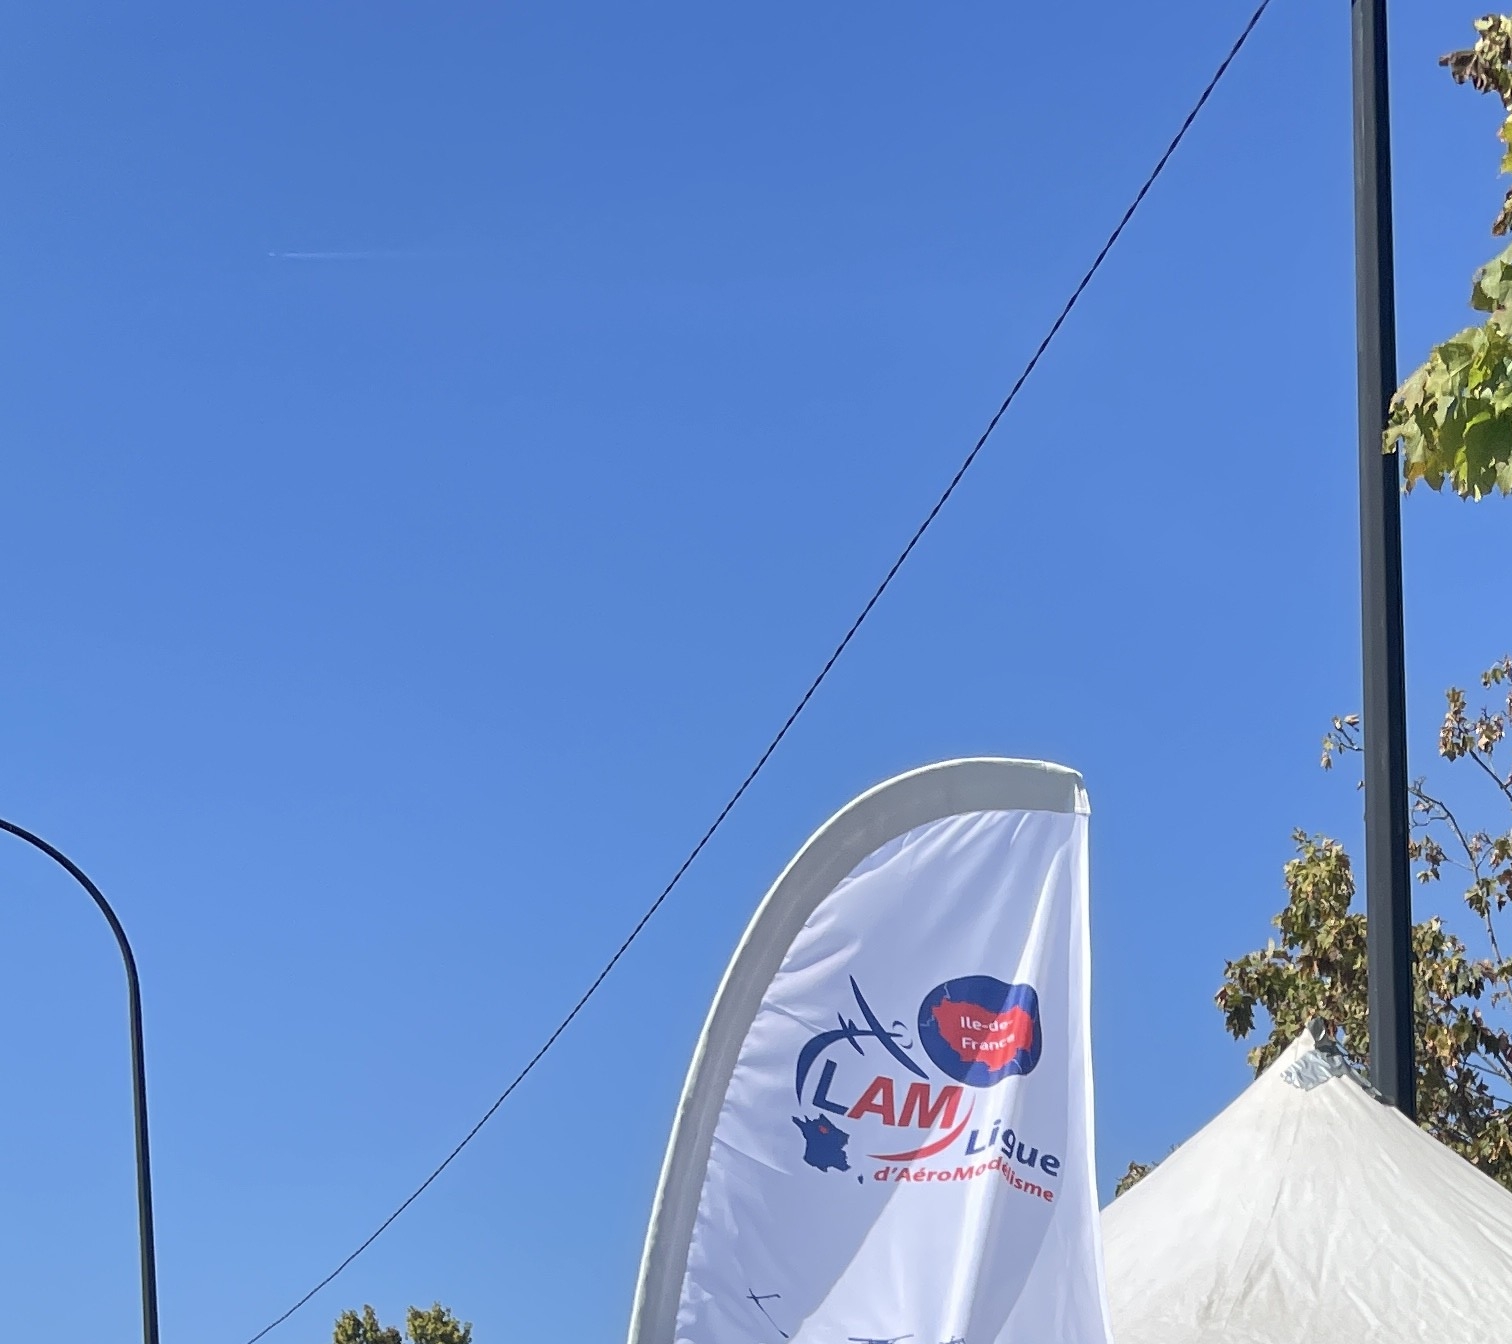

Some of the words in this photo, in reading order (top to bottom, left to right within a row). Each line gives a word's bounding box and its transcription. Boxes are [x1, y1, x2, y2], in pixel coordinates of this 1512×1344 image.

[961, 1035, 1015, 1052] France
[812, 1059, 964, 1129] LAM
[966, 1119, 1061, 1178] Ligue
[873, 1157, 1055, 1203] d'AéroModélisme
